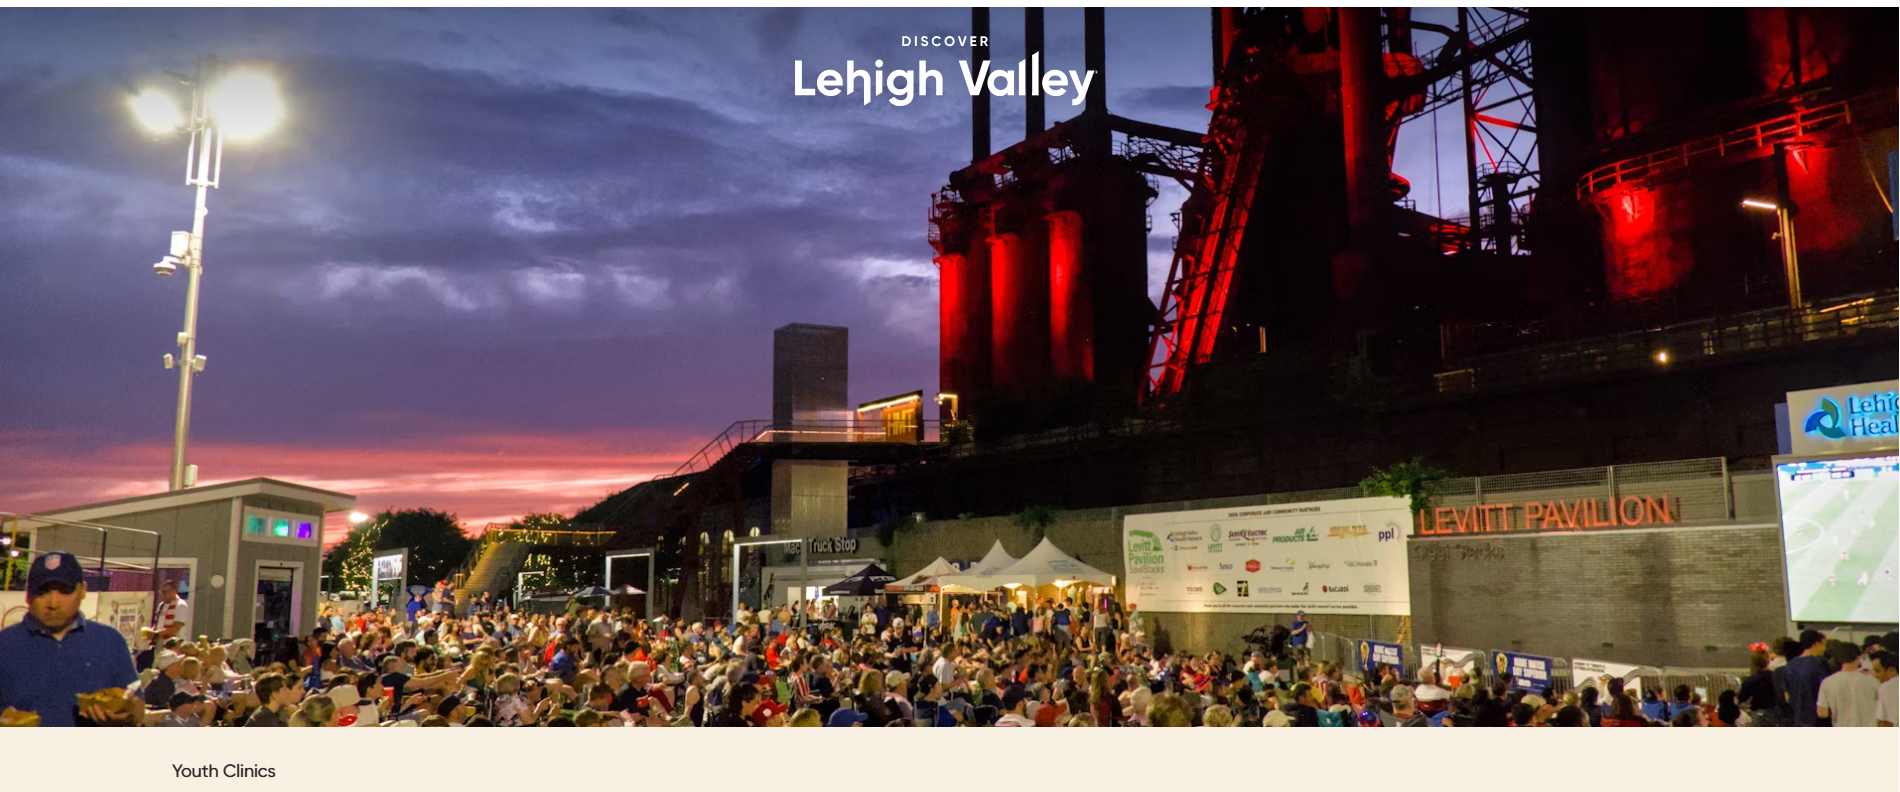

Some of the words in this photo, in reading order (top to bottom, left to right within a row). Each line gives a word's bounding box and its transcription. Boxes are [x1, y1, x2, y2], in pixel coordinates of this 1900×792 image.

[1420, 503, 1513, 534] LEVITT
[1525, 493, 1670, 529] PAVILION
[1294, 528, 1306, 536] AIR
[1378, 527, 1395, 542] ppl
[783, 541, 801, 554] Mac
[808, 538, 833, 553] Truck
[835, 536, 857, 553] Stop
[1128, 540, 1152, 551] Levitt
[1272, 535, 1305, 543] PRODUCTS
[1128, 552, 1164, 565] Pavilion
